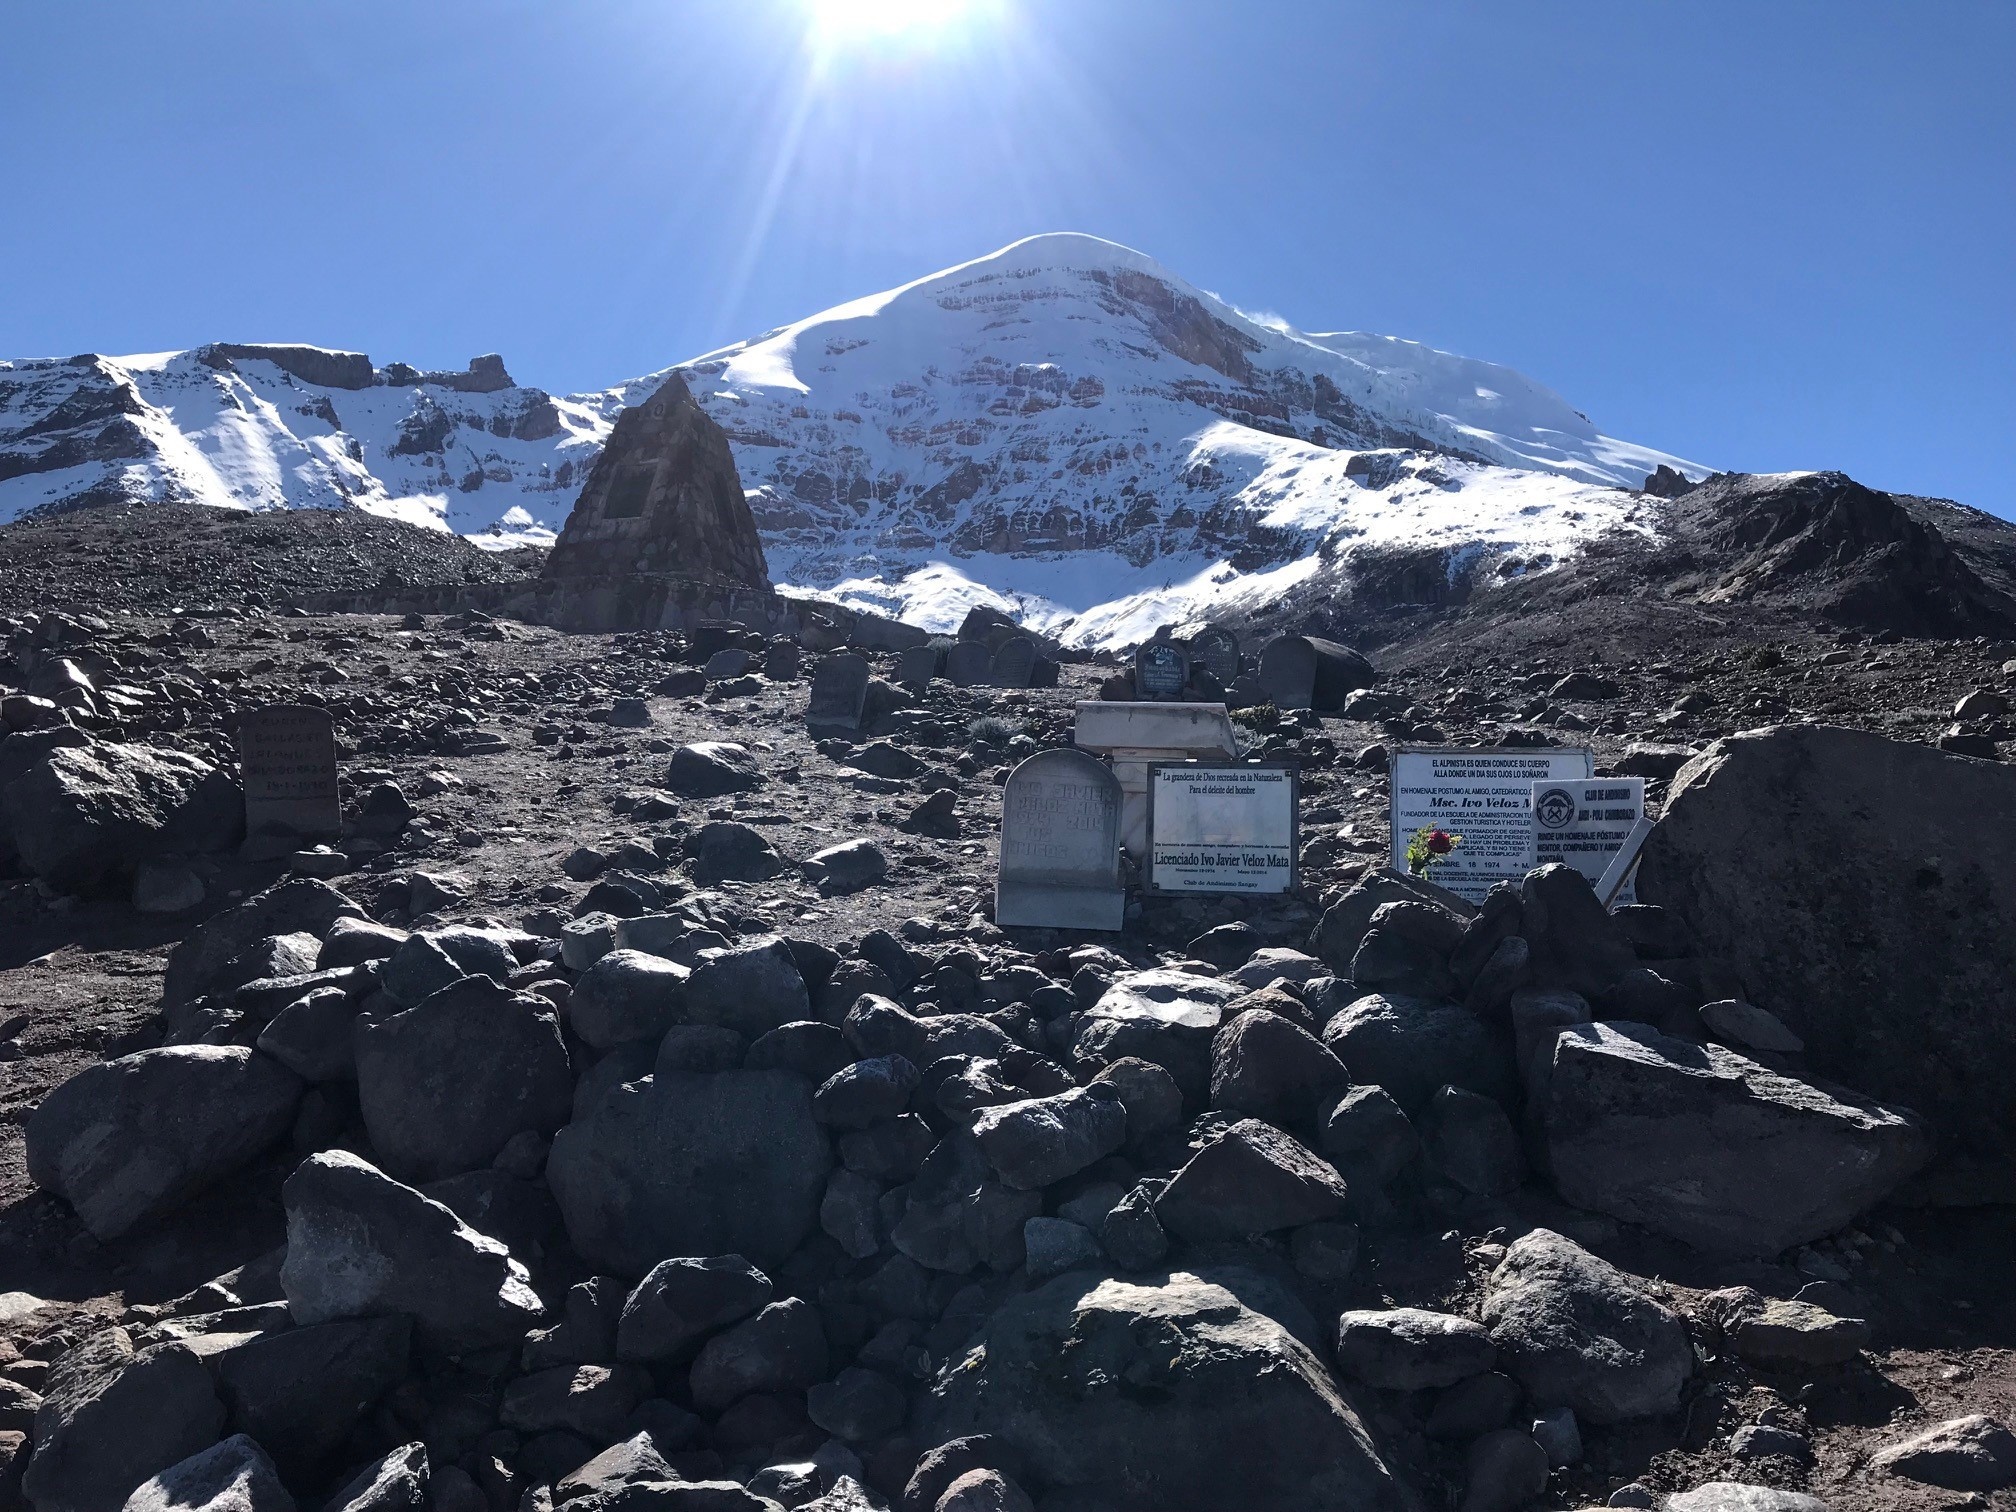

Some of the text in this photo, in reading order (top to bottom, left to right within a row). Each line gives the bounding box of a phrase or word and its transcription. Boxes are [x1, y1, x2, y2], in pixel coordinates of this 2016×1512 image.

[1432, 760, 1550, 768] EL ALPINISTA ES QUIEN CONDUCE SU CUERPO
[1171, 773, 1195, 782] grandeza
[1203, 773, 1216, 781] Dios
[1253, 773, 1282, 782] Naturaleza
[1434, 770, 1447, 778] ALLA
[1448, 770, 1467, 778] DONDE
[1486, 770, 1497, 778] SUS
[1522, 769, 1548, 778] SOÑARON
[1189, 785, 1256, 794] Para el deleite del hombre
[1585, 790, 1597, 801] CLUB
[1429, 798, 1458, 808] Msc.
[1461, 798, 1482, 808] Ivo
[1486, 798, 1519, 808] Veloz
[1565, 832, 1596, 840] HOMENAJE
[1597, 830, 1625, 840] PÓSTUMO
[1537, 844, 1562, 852] MENTOR,
[1563, 842, 1598, 851] COMPAÑERO
[1154, 852, 1289, 867] Licenciado Ivo Javier Veloz Mata
